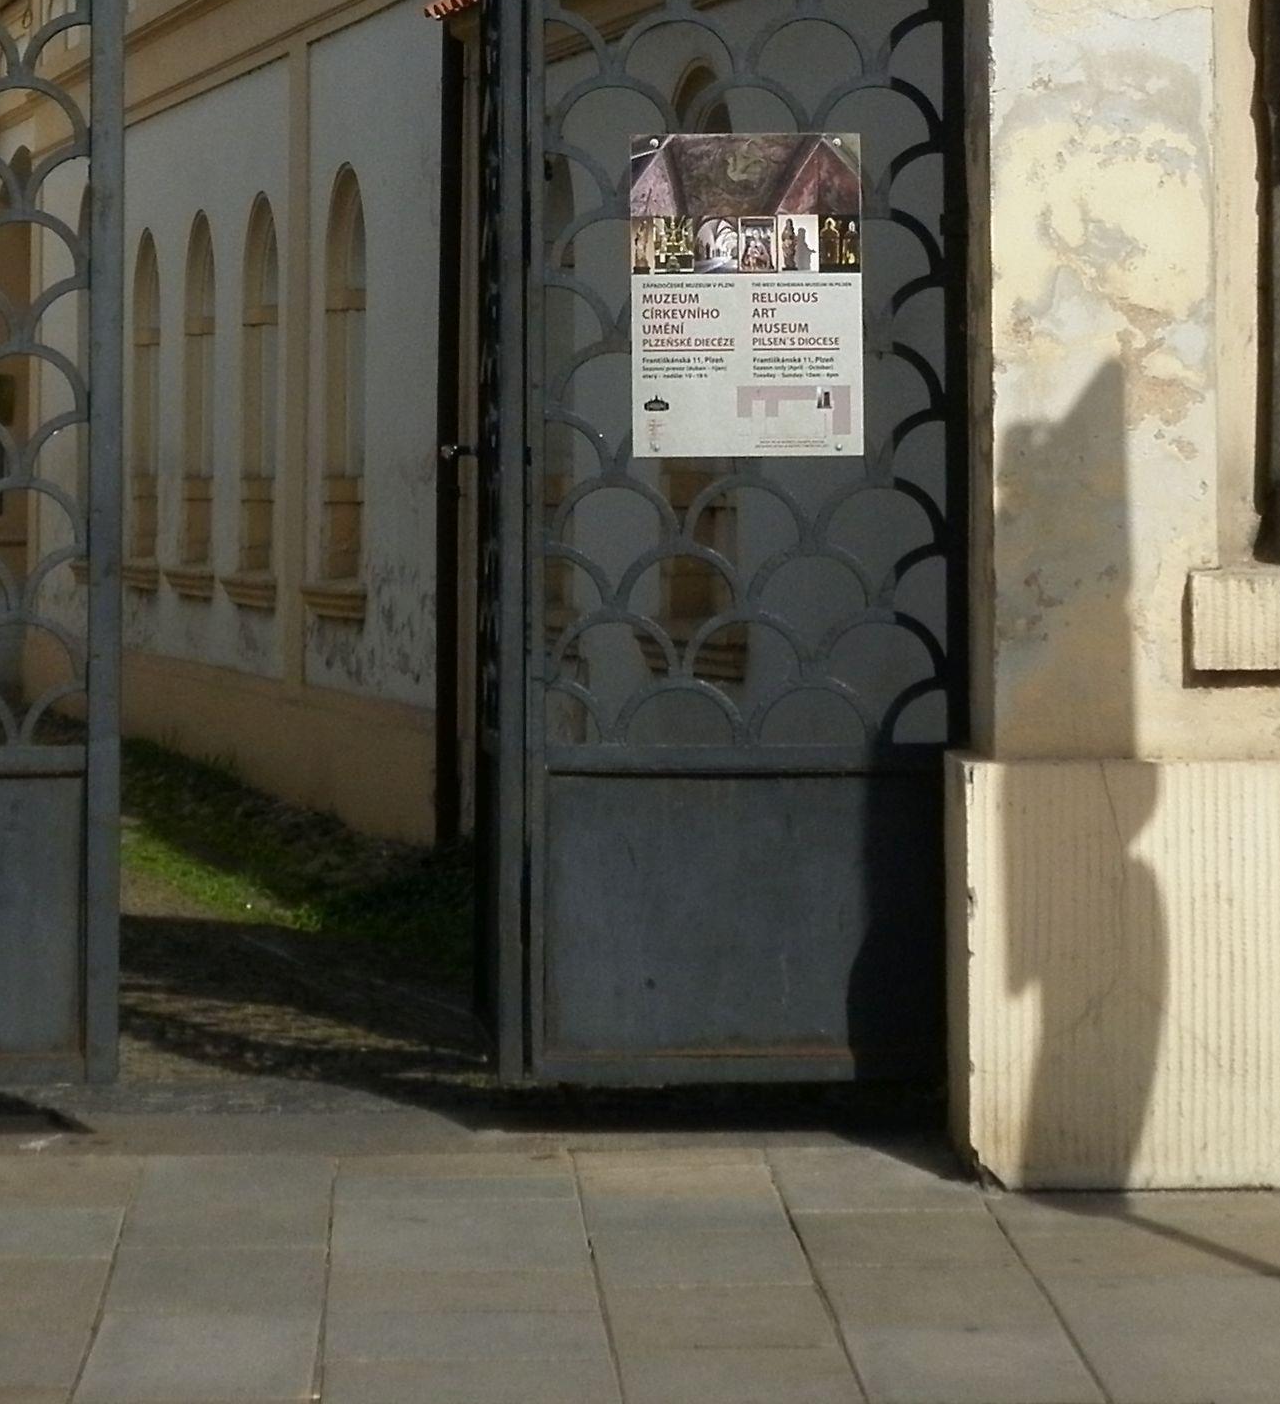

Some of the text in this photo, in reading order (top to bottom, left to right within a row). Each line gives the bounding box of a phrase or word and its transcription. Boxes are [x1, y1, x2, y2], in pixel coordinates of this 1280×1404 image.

[642, 293, 700, 304] MUZEUM
[751, 292, 818, 303] RELIGIOUS
[642, 306, 720, 319] CÍRKEVNÍHO
[751, 308, 777, 319] ART
[642, 322, 685, 335] UMĚNÍ
[752, 323, 809, 333] MUSEUM
[642, 336, 735, 347] PLZEŇSKÉ DIECÉZE
[798, 336, 840, 346] DIOCESE
